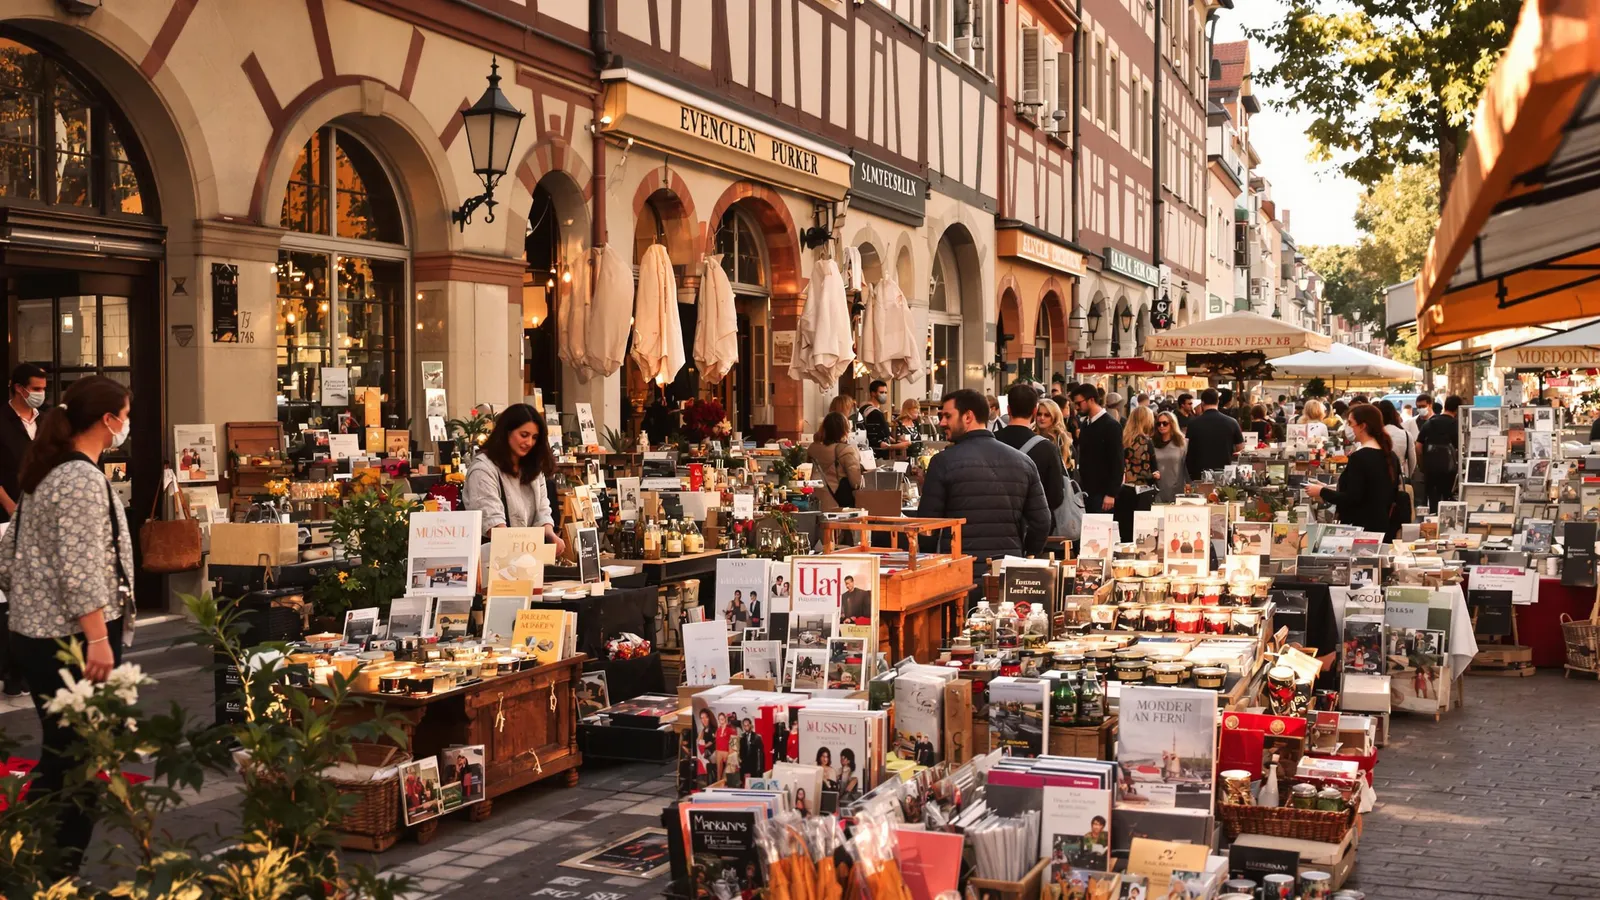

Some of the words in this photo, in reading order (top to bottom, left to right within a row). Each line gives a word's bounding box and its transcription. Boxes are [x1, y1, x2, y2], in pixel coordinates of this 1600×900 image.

[680, 105, 757, 154] EVENCLEN
[771, 139, 819, 175] PURKER
[1137, 700, 1192, 712] MORDER
